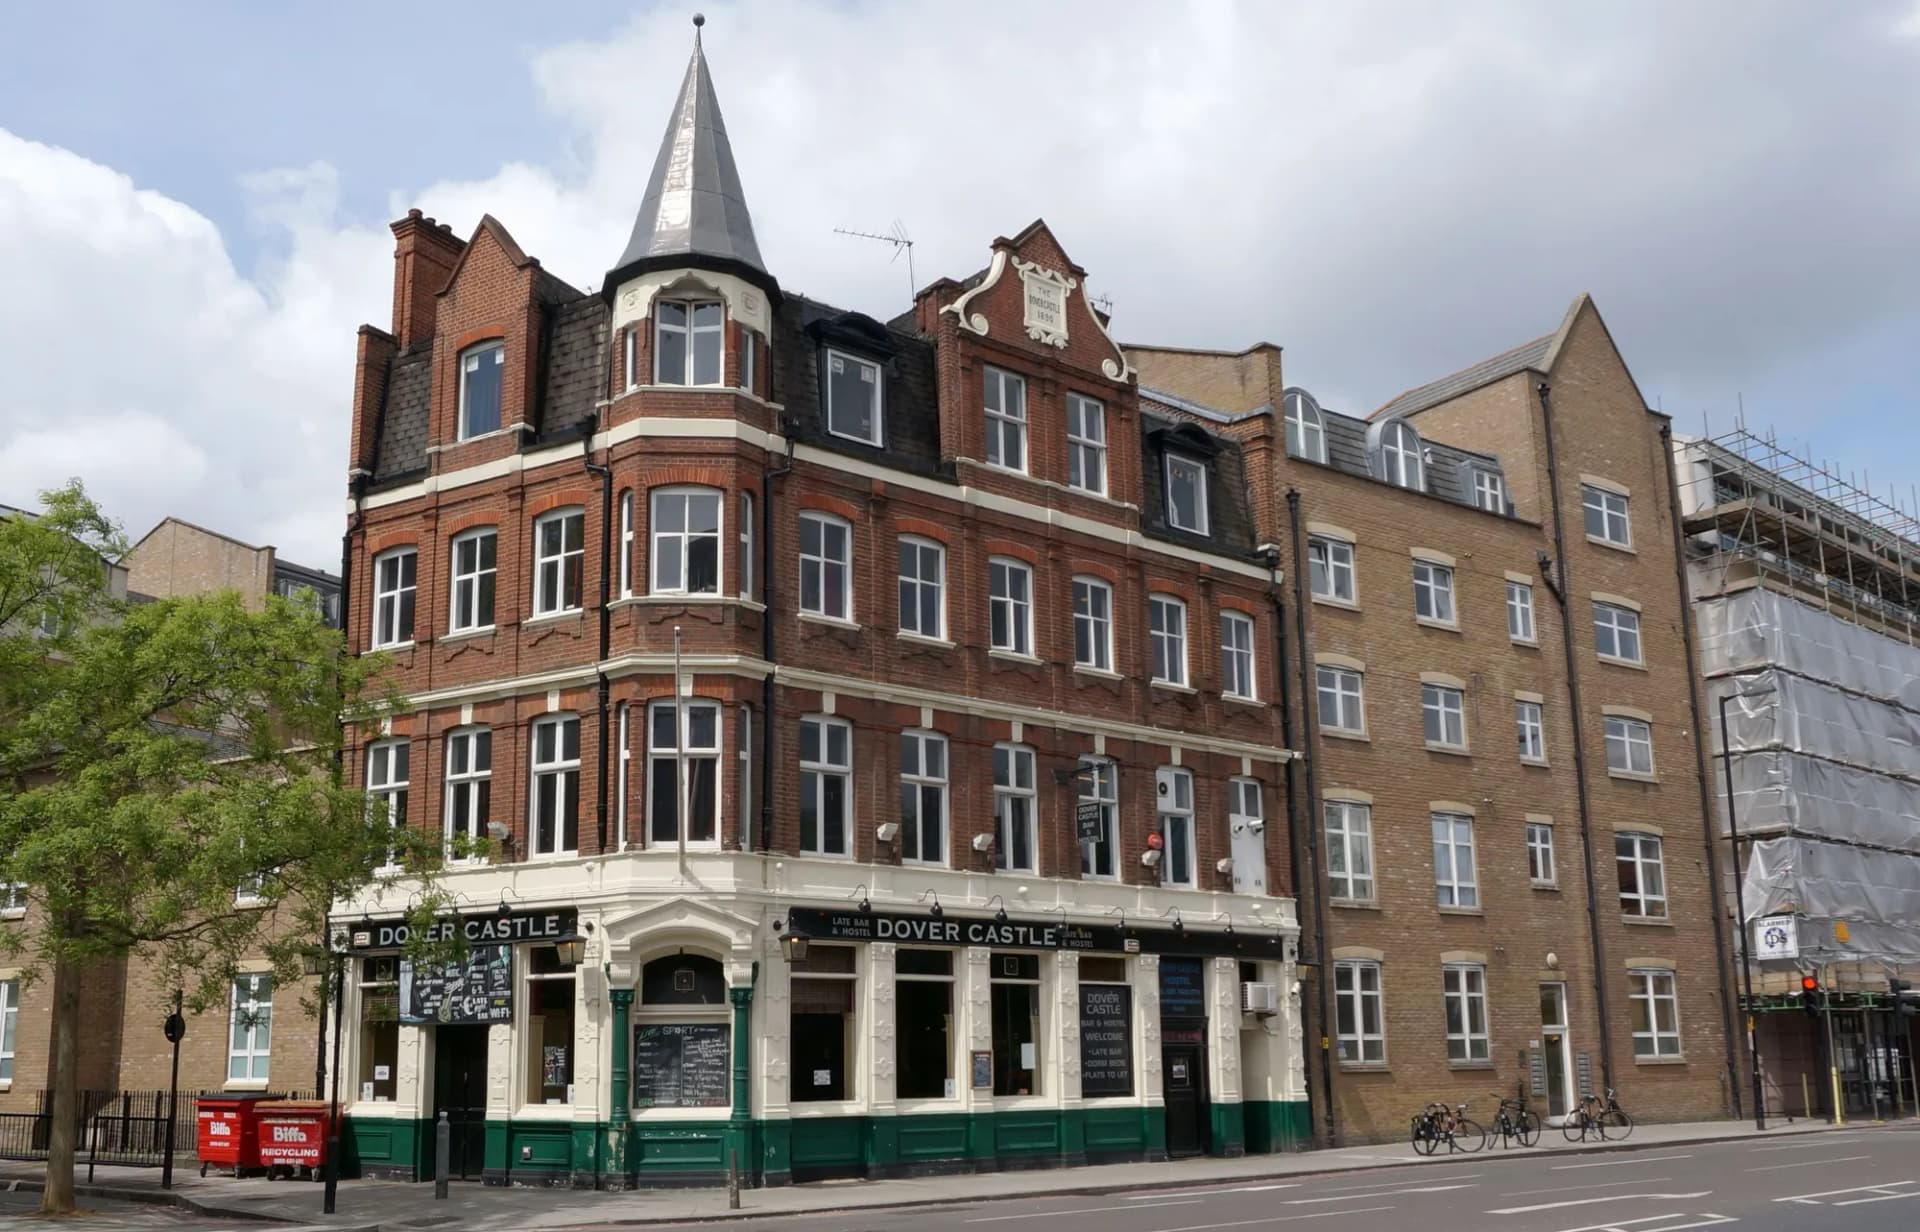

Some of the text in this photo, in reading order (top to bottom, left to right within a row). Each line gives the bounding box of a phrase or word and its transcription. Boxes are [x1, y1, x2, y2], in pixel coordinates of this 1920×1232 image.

[832, 917, 870, 927] LATE BAR
[464, 915, 559, 940] CASTLE
[832, 927, 871, 937] & HOSTEL
[877, 919, 1056, 945] DOVER CASTLE
[1070, 939, 1094, 948] HOSTEL
[1087, 993, 1120, 1004] DOVER
[1086, 1004, 1121, 1014] CASTLE
[662, 1026, 694, 1035] SPORT
[1085, 1032, 1124, 1041] WELCOME
[210, 1121, 231, 1135] Biffa
[273, 1127, 307, 1142] Biffa
[261, 1148, 319, 1157] RECYCLING
